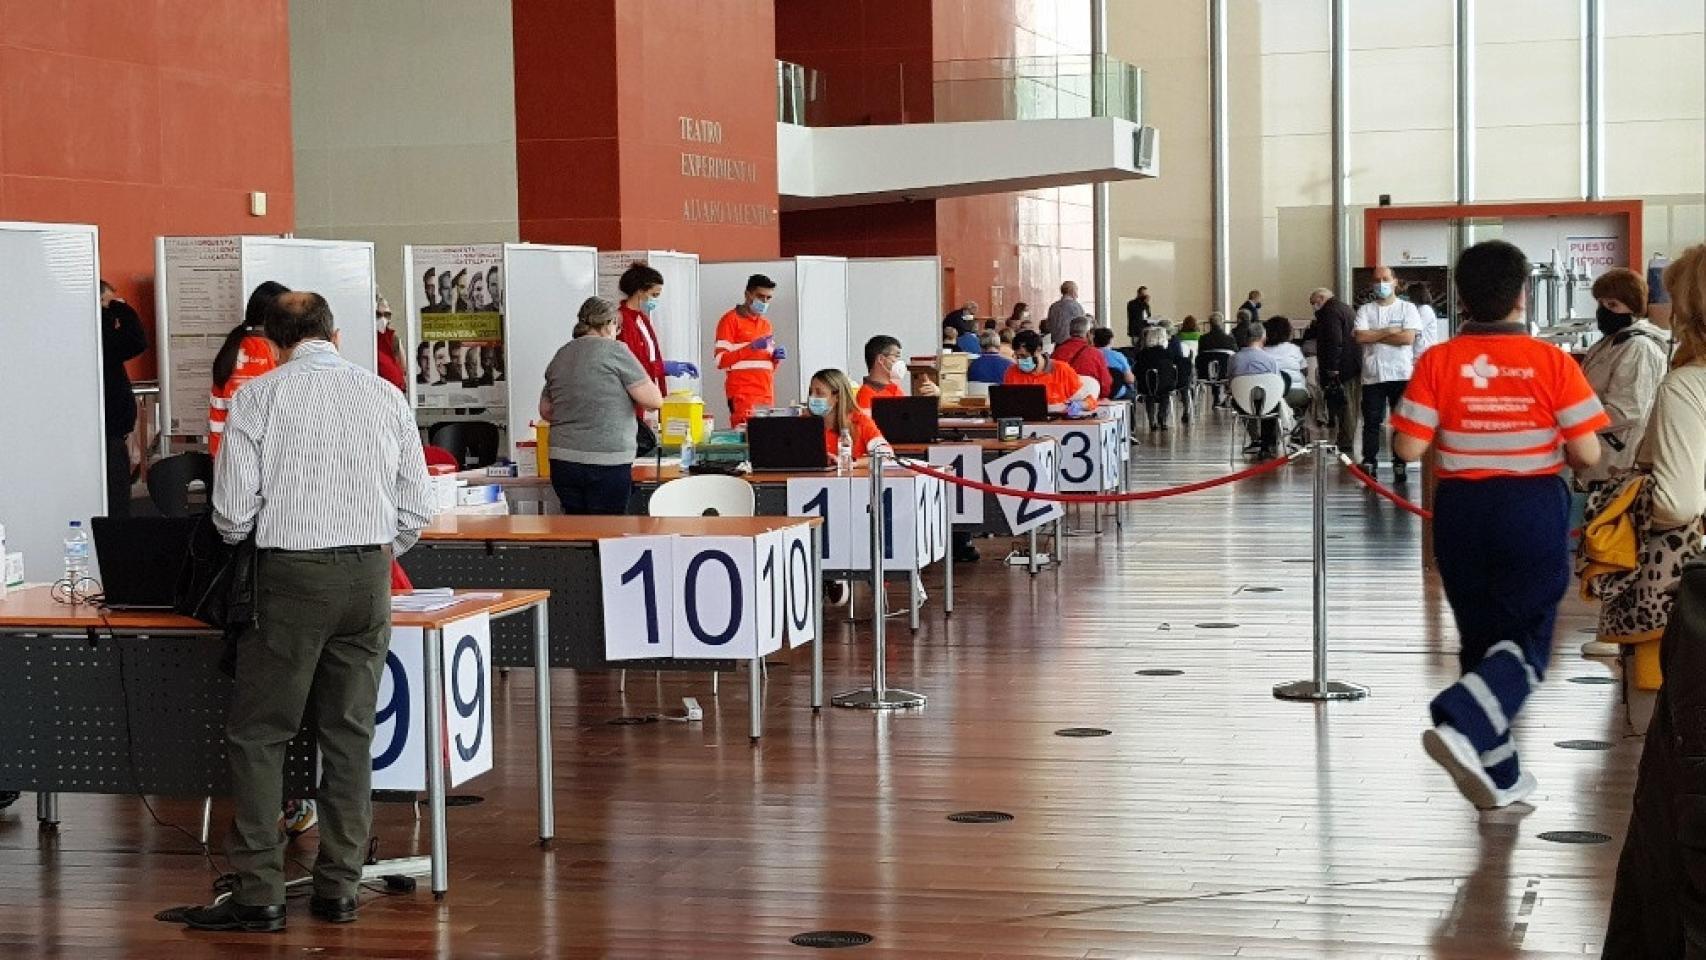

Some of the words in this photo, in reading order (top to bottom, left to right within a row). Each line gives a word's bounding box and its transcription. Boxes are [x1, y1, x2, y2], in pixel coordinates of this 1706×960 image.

[679, 116, 722, 144] TEATRO
[681, 152, 756, 182] EXPERIMENTAL
[1570, 242, 1616, 251] PUESTO
[621, 549, 743, 646] 10
[762, 538, 810, 640] 10
[371, 650, 411, 771] 9
[452, 634, 485, 763] 9
